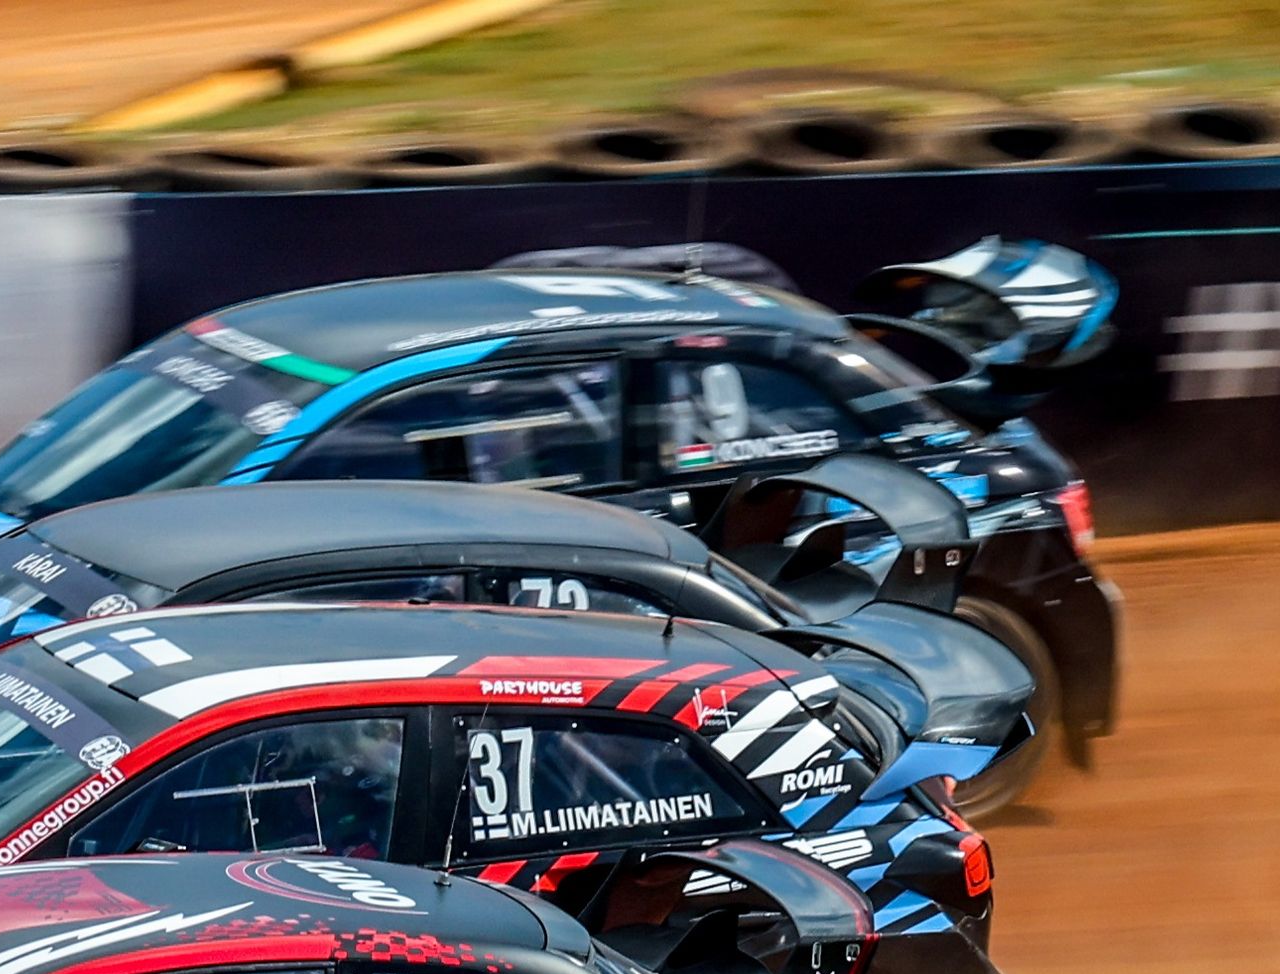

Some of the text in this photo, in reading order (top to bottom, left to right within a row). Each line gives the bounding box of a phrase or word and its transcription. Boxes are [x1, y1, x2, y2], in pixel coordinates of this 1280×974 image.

[11, 552, 68, 584] KÁRAI
[480, 680, 583, 696] PARTHOUSE
[469, 726, 535, 816] 37
[780, 763, 844, 794] ROMI
[511, 792, 714, 838] M.LIIMATAINEN
